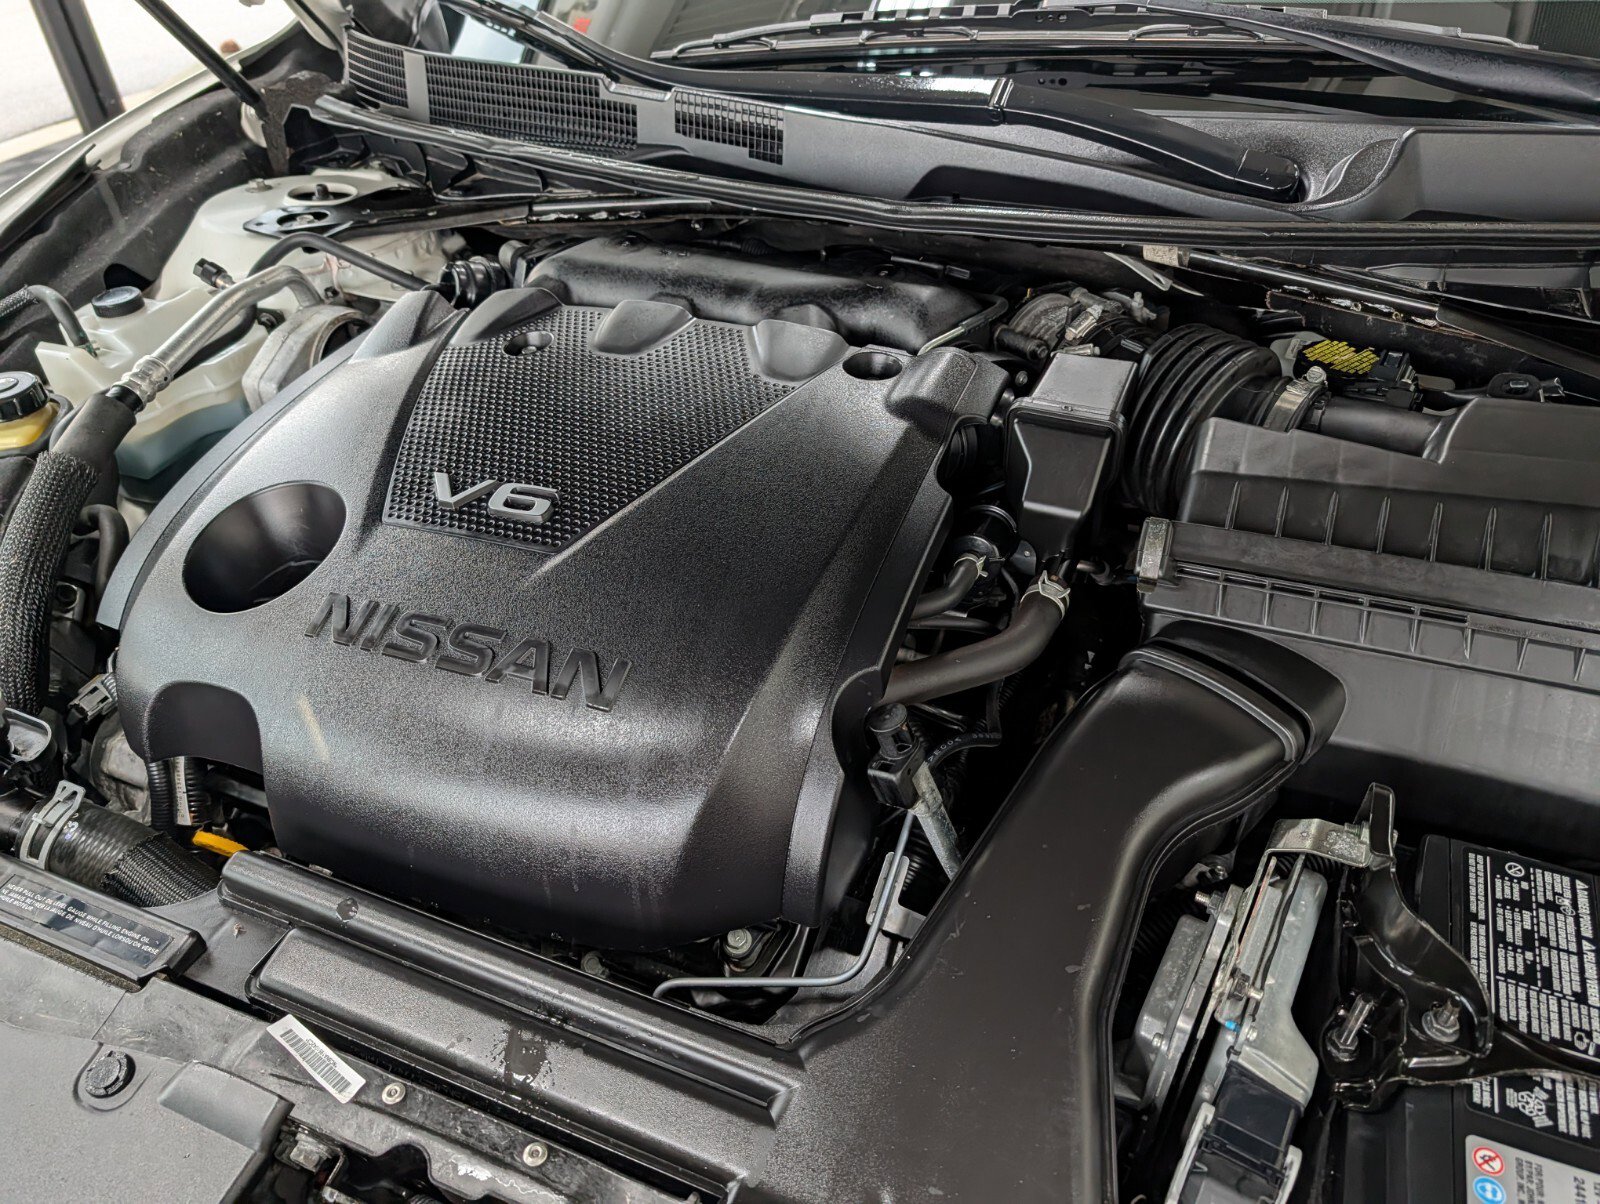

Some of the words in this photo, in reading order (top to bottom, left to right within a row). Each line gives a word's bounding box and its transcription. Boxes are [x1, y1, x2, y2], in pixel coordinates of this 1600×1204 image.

[434, 471, 560, 524] V6
[304, 592, 632, 712] NISSAN
[7, 883, 24, 894] NEVER
[22, 888, 36, 898] PULL
[34, 894, 48, 902] OUT
[67, 906, 88, 918] GAUGE
[86, 914, 104, 925] WHILE
[101, 920, 123, 932] FILLING
[121, 928, 142, 940] ENGINE
[65, 913, 76, 921] DE
[74, 917, 94, 929] NIVEAU
[141, 944, 160, 955] VERSE
